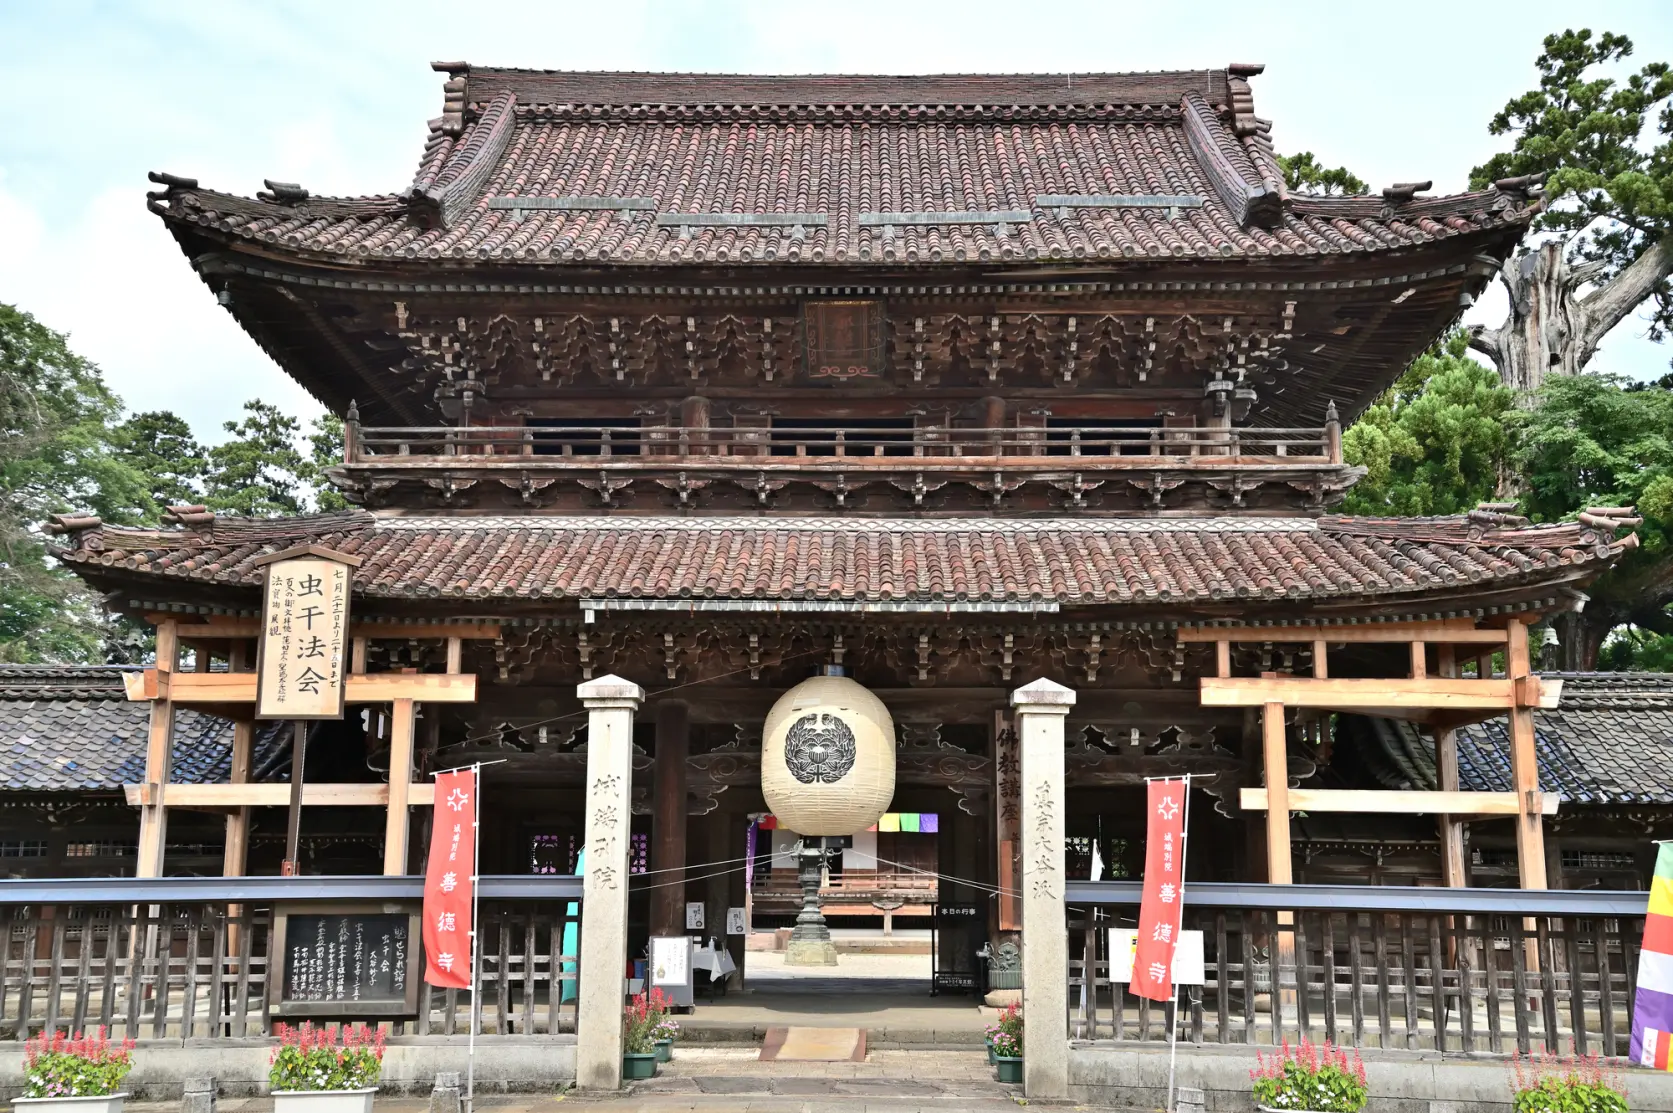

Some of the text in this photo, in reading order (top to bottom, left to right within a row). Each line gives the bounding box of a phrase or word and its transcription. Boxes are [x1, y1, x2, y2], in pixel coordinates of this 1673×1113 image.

[295, 573, 328, 695] 虫干法会
[997, 725, 1021, 825] 佛教講座
[1163, 832, 1173, 872] 城端別院
[941, 908, 976, 916] 本日の行事
